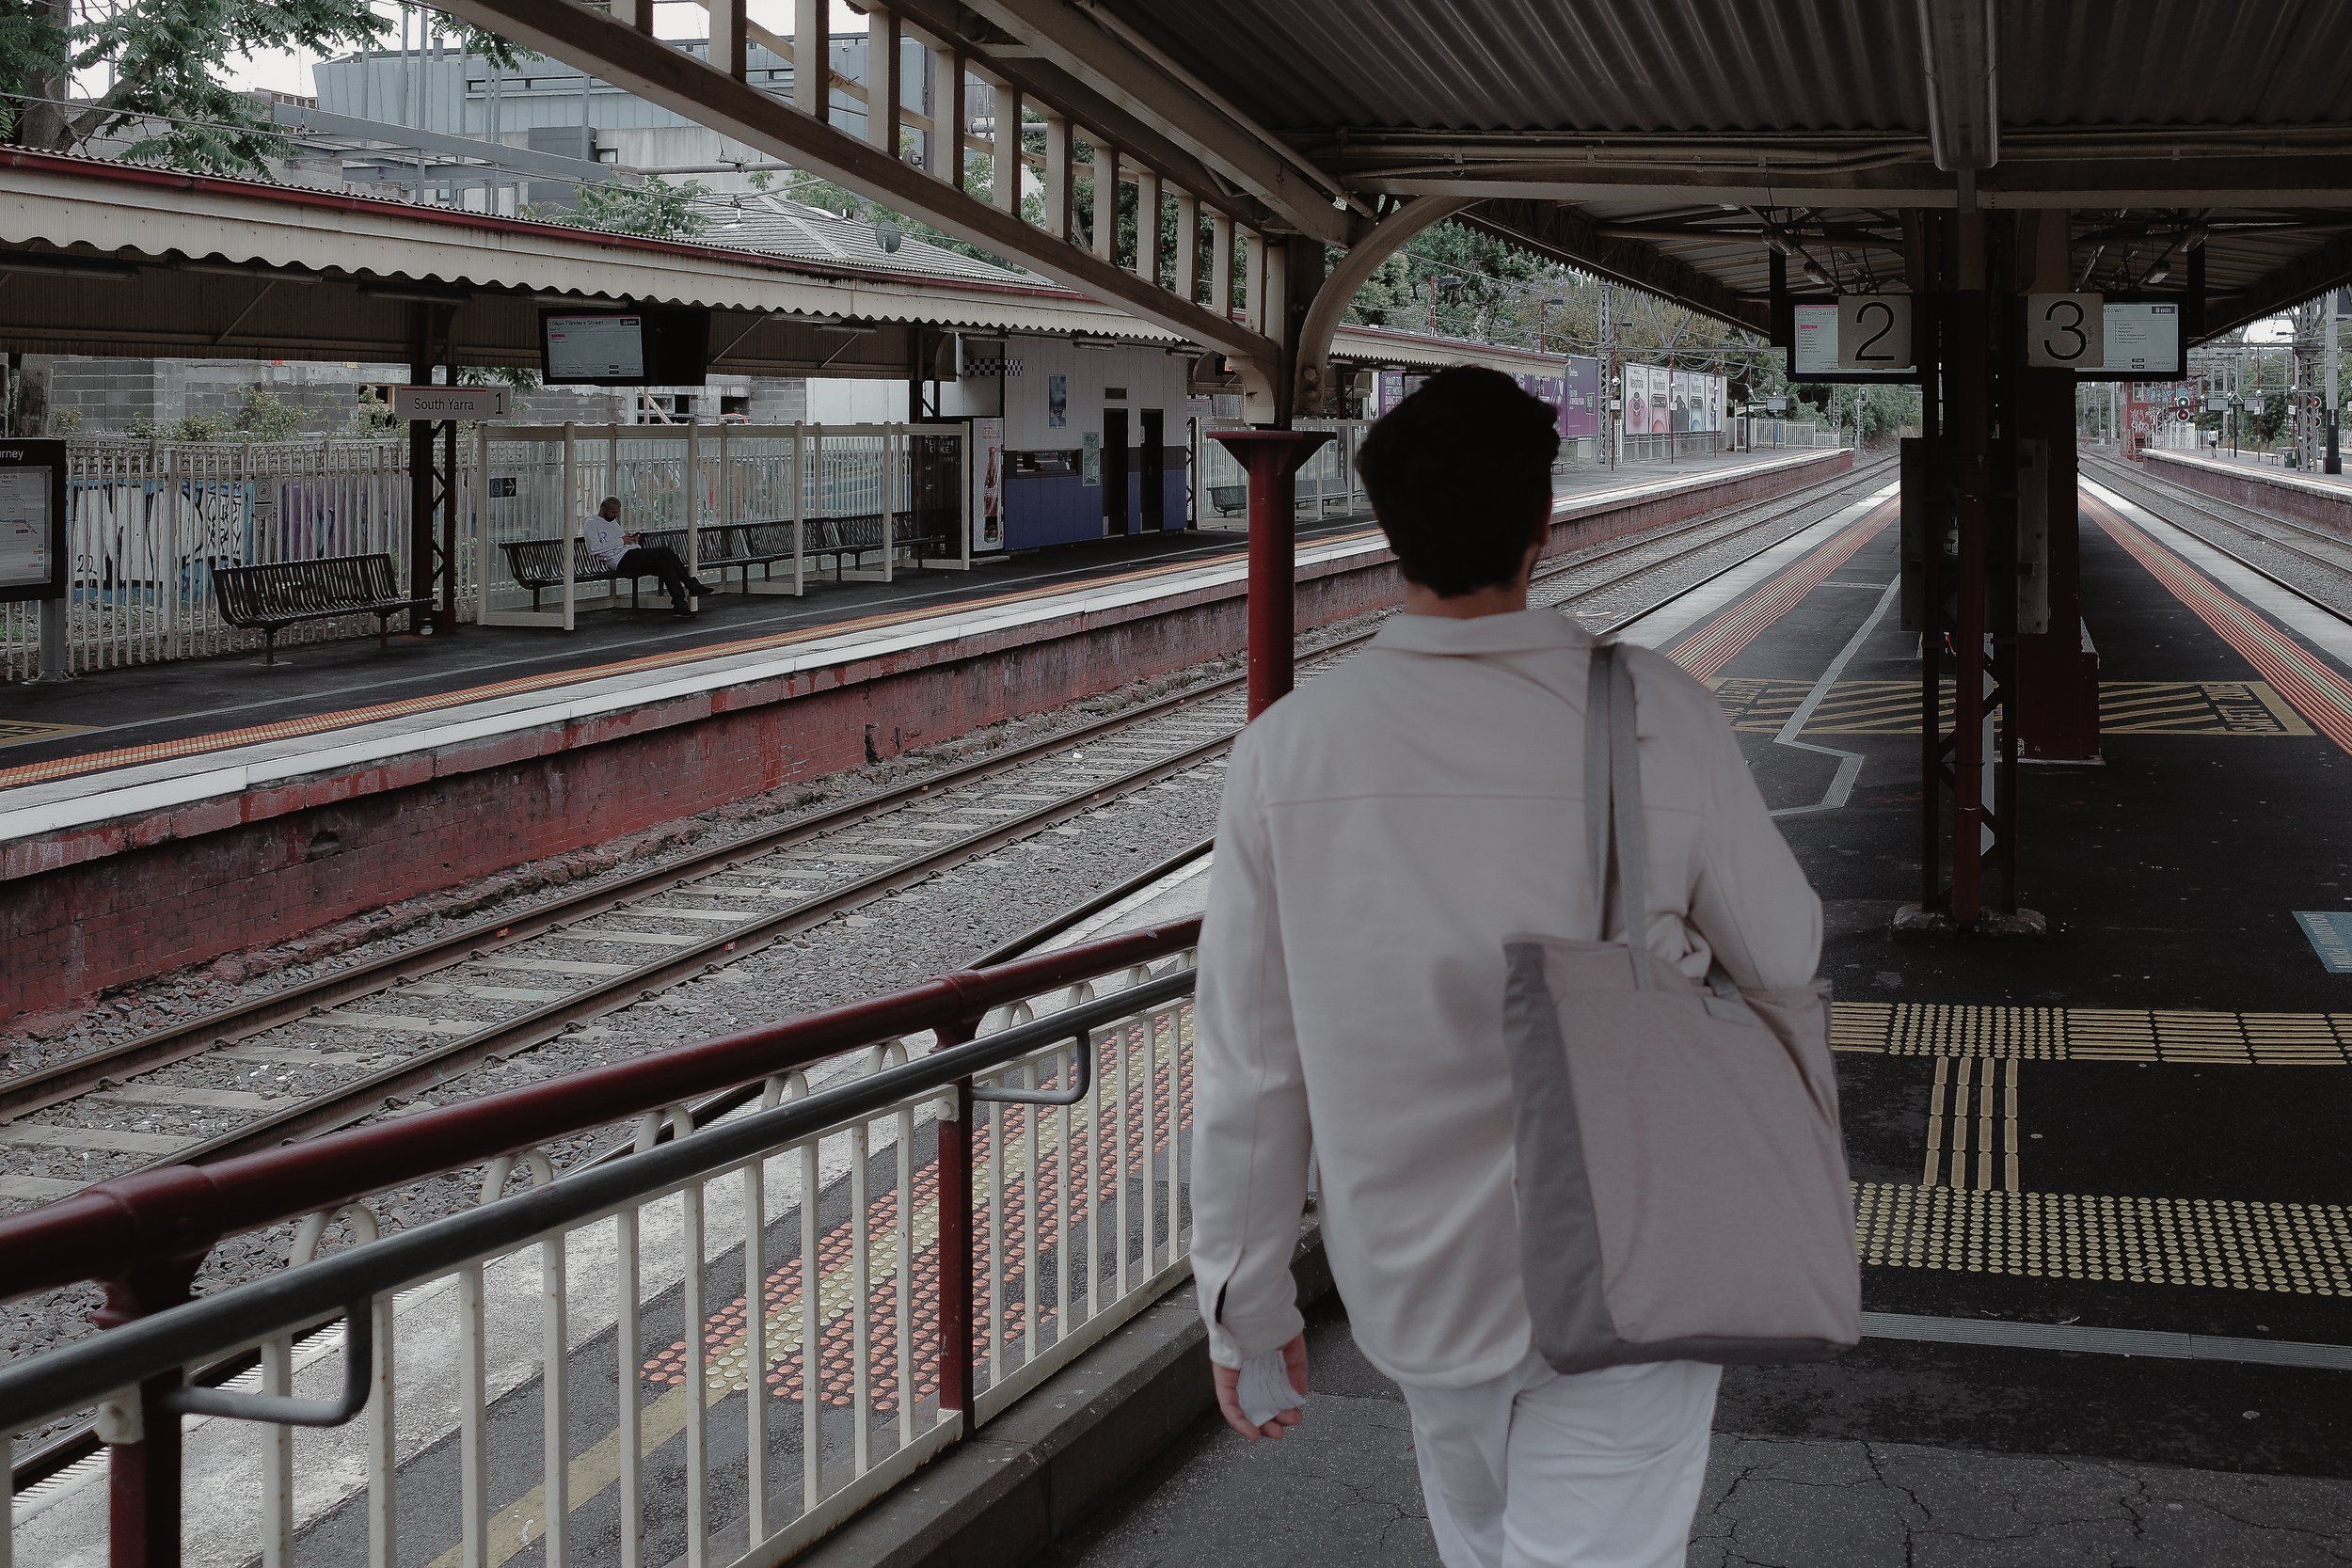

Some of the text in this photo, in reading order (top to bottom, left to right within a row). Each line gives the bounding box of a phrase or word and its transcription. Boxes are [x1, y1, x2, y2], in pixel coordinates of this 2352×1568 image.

[1854, 301, 1895, 361] 2
[2043, 300, 2087, 361] 3
[414, 391, 503, 415] South Yarra 1
[2201, 685, 2280, 731] SAFETY ZONE
